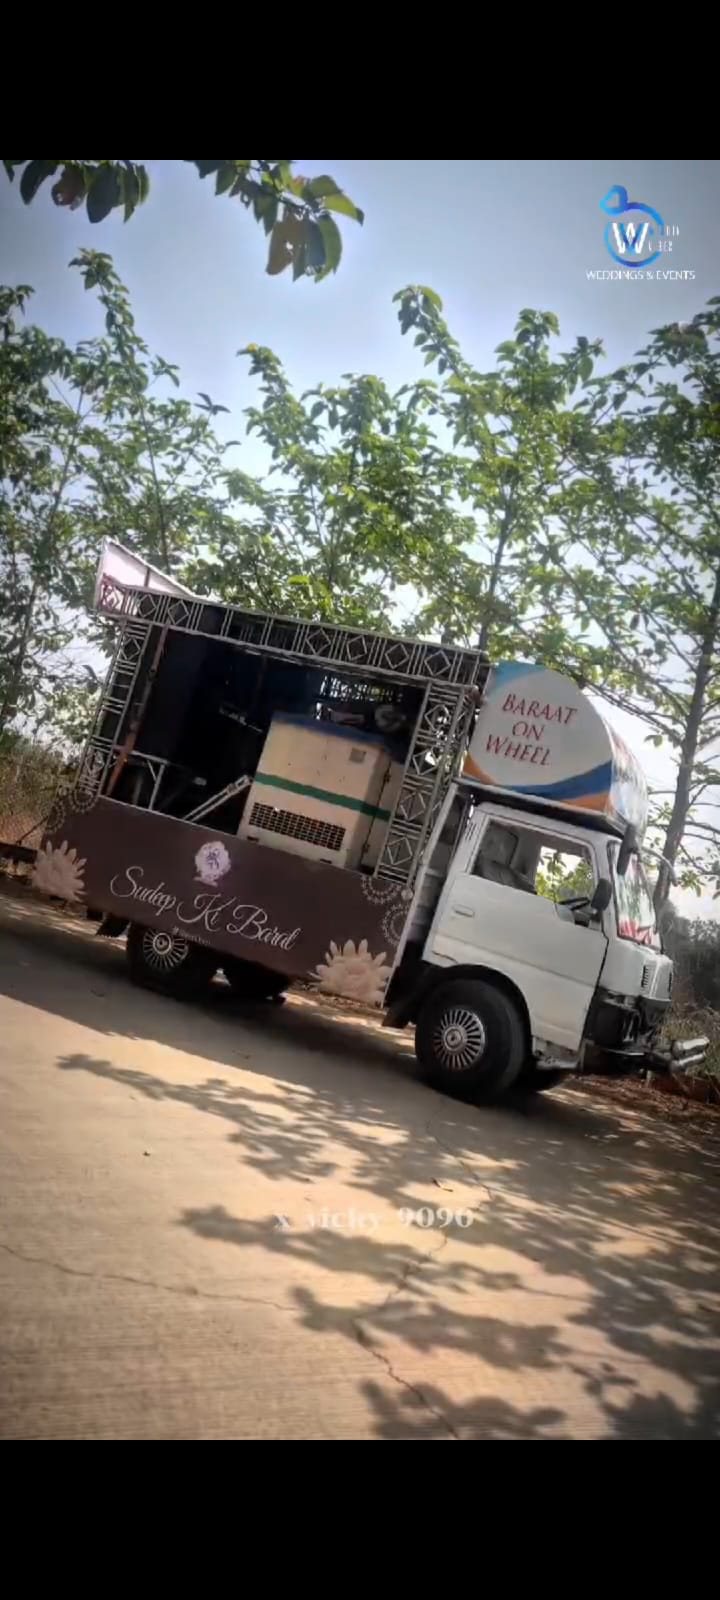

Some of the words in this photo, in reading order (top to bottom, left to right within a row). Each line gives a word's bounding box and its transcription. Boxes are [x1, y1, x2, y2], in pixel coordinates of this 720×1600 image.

[502, 693, 578, 725] BARAAT
[511, 720, 545, 740] ON
[485, 734, 550, 766] WHEEL
[176, 892, 236, 932] Ki
